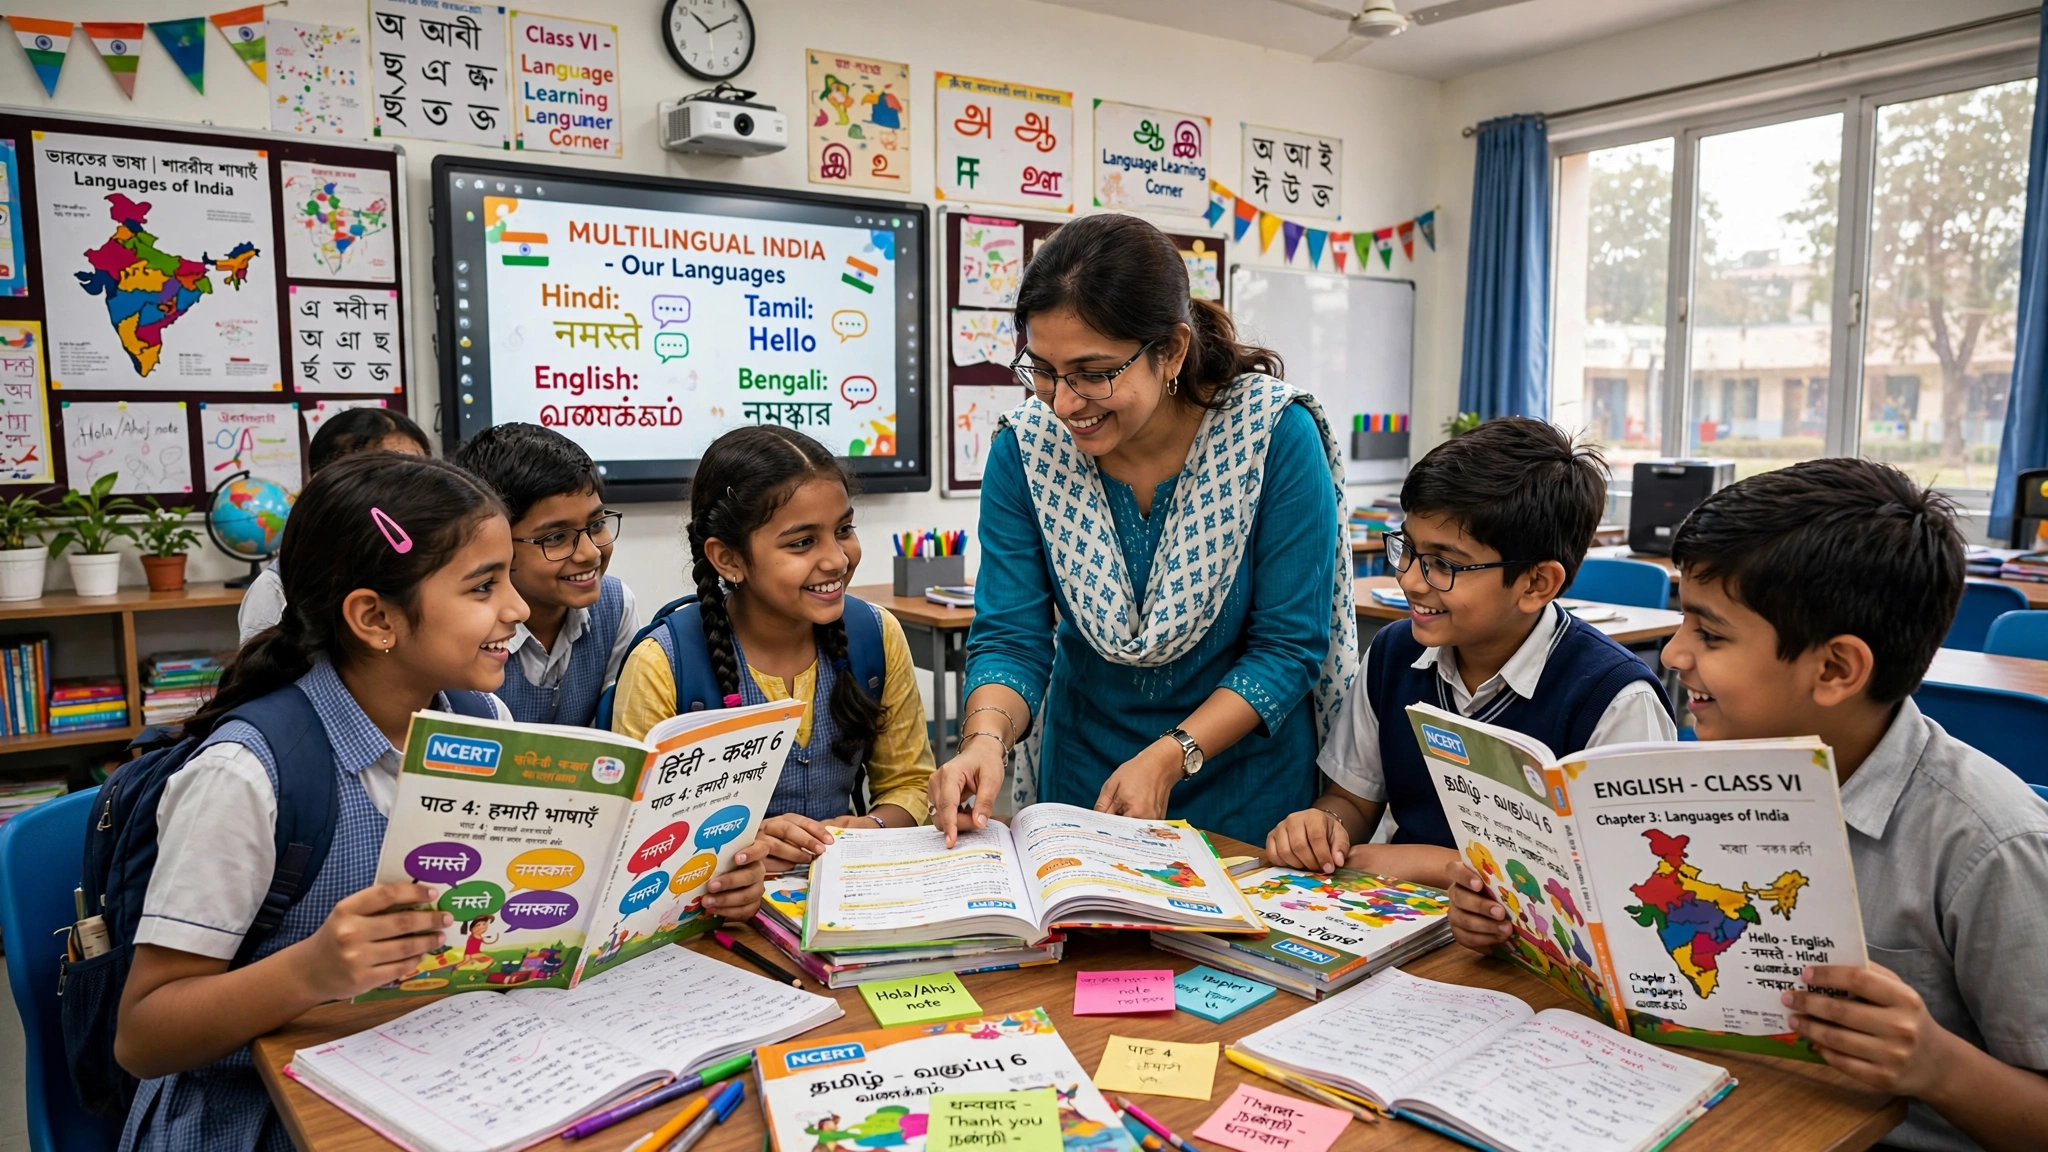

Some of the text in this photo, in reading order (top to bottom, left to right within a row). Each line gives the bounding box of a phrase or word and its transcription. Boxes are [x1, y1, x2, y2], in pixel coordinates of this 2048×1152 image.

[678, 6, 688, 17] 10
[375, 11, 407, 41] অ
[674, 21, 682, 32] 9
[738, 30, 743, 41] 3
[526, 25, 574, 48] Class
[579, 32, 597, 51] VI
[680, 40, 686, 50] 8
[692, 53, 698, 63] 7
[723, 56, 730, 67] 5
[732, 47, 739, 55] 4
[521, 53, 613, 86] Language
[707, 60, 714, 70] 6
[524, 81, 608, 112] Learning
[549, 128, 609, 150] Corner
[954, 104, 1057, 153] அ ஆ
[1133, 119, 1165, 152] ஆ
[45, 149, 107, 167] ভারতের
[112, 155, 146, 171] ভাষা
[1103, 148, 1206, 181] Language Learning
[1252, 138, 1275, 164] অ
[1284, 142, 1312, 170] আ
[74, 171, 234, 196] Languages of India
[1146, 178, 1183, 198] Corner
[568, 220, 826, 262] MULTILINGUAL INDIA
[621, 254, 665, 277] Our
[672, 257, 786, 287] Languages
[541, 283, 620, 310] Hindi:
[745, 294, 814, 320] Tamil:
[299, 329, 324, 349] অ
[553, 313, 643, 350] नमस्ते
[749, 326, 816, 352] Hello
[535, 365, 639, 397] English:
[739, 368, 828, 398] Bengali:
[431, 741, 496, 763] NCERT
[1426, 731, 1462, 753] NCERT
[657, 747, 705, 785] हिंदी
[722, 735, 768, 764] कक्षा
[770, 730, 784, 751] 6
[651, 790, 674, 811] पाठ
[678, 787, 692, 802] 4:
[695, 772, 728, 798] हमारी
[732, 761, 768, 785] भाषाएँ
[1594, 777, 1684, 799] ENGLISH
[1704, 774, 1773, 792] CLASS
[1777, 774, 1802, 792] VI
[420, 795, 457, 813] पाठ
[462, 800, 481, 816] 4:
[488, 801, 539, 821] हमारी
[545, 806, 599, 829] भाषाएँ
[1596, 809, 1789, 827] Chapter 3: Languages of India
[1543, 816, 1552, 834] 6
[640, 834, 676, 861] नमस्ते
[418, 853, 470, 871] नमस्ते
[628, 878, 663, 903] नमस्ते
[1280, 943, 1328, 961] NCERT
[1748, 932, 1779, 944] Hello
[1791, 935, 1835, 950] English
[1750, 947, 1784, 960] नमस्ते
[876, 983, 956, 1001] Hola/Ahoj
[906, 1000, 941, 1010] note
[791, 1047, 858, 1065] NCERT
[1163, 1049, 1173, 1058] 4
[809, 1070, 884, 1097] தமிழ்
[914, 1057, 1004, 1079] வகுப்பு
[1011, 1054, 1027, 1066] 6
[945, 1115, 1042, 1130] Thank you
